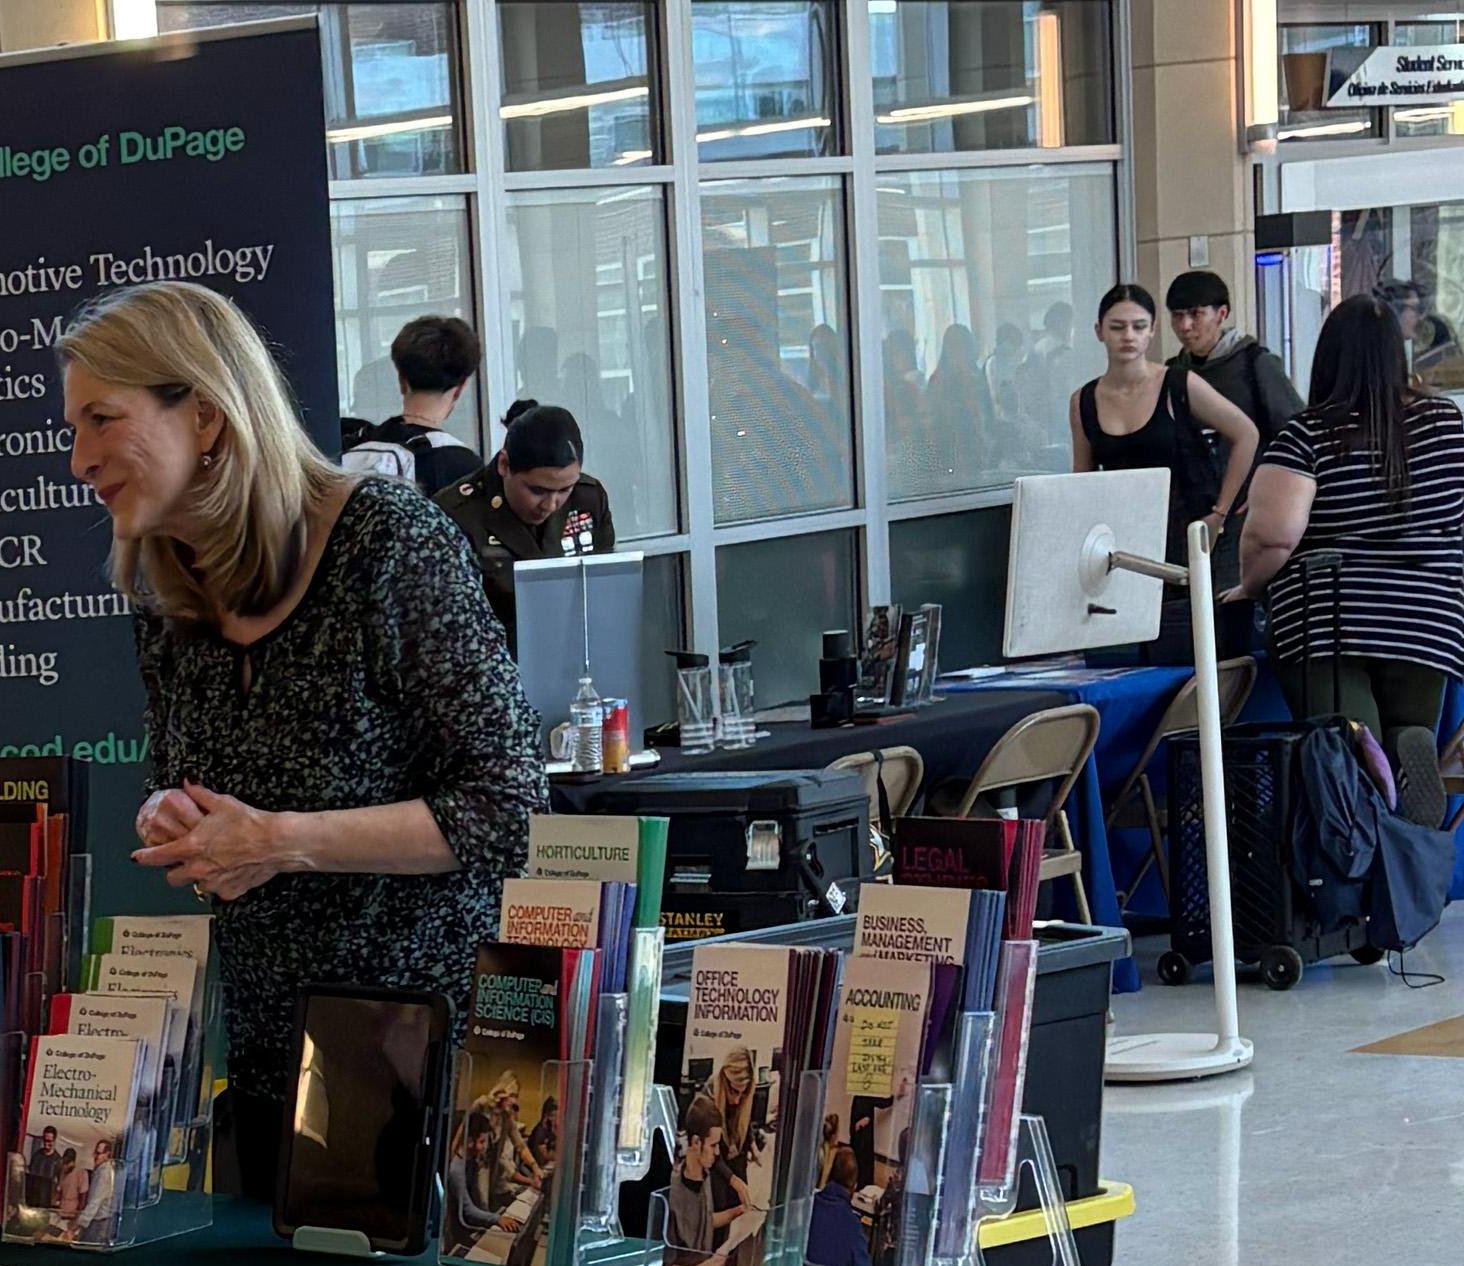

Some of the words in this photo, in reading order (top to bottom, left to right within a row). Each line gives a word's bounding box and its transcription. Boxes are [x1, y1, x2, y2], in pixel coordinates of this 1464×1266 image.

[79, 135, 110, 168] of
[120, 126, 246, 165] DuPage
[90, 239, 274, 289] Technology
[536, 845, 630, 861] HORTICULTURE
[902, 847, 969, 872] LEGAL
[507, 904, 572, 922] COMPUTER
[573, 906, 594, 923] and
[660, 911, 724, 926] STANLEY
[506, 920, 589, 938] INFORMATION
[863, 914, 927, 934] BUSINESS,
[861, 932, 953, 953] MANAGEMENT
[478, 974, 542, 993] COMPUTER
[696, 970, 739, 987] OFFICE
[476, 989, 554, 1009] INFORMATION
[695, 987, 780, 1005] TECHNOLOGY
[845, 987, 921, 1011] ACCOUNTING
[474, 1003, 529, 1022] SCIENCE
[531, 1008, 555, 1029] (CIS)
[694, 1004, 778, 1022] INFORMATION
[43, 1064, 97, 1081] Electro-
[40, 1082, 117, 1101] Mechanical
[38, 1100, 112, 1124] Technology
